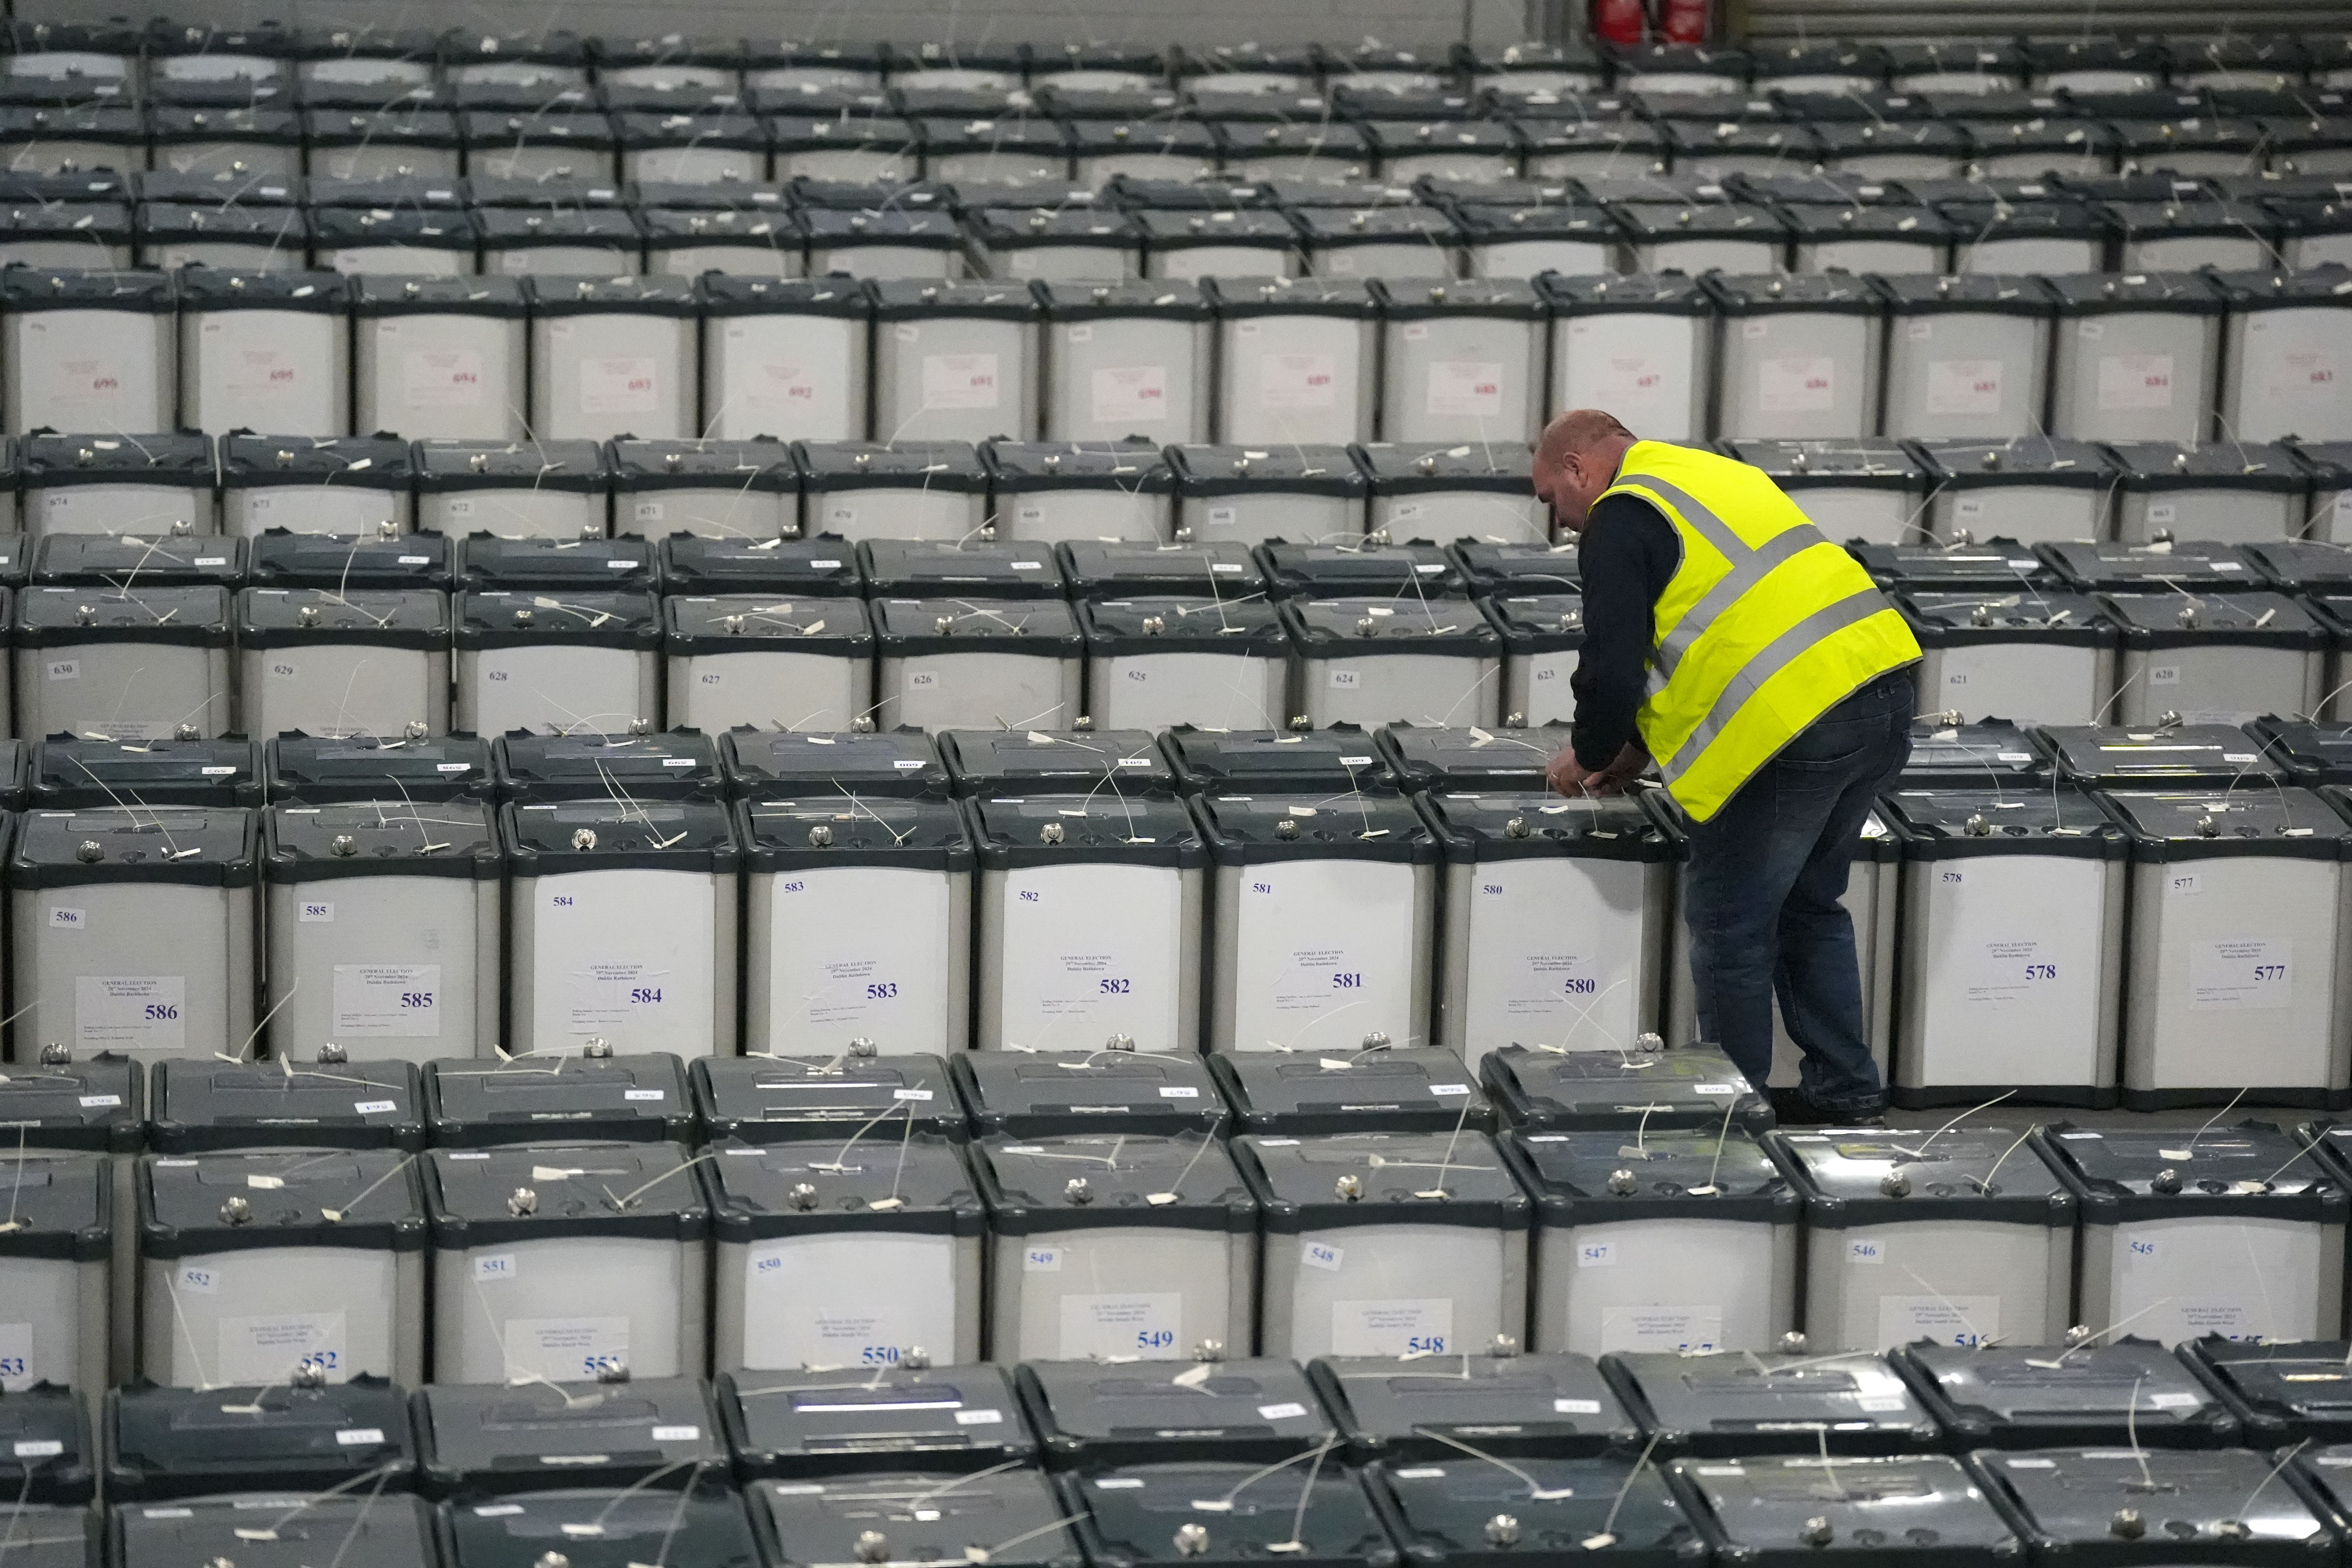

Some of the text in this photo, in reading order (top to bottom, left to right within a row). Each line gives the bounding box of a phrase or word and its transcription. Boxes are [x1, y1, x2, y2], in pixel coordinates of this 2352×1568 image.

[54, 664, 72, 673] 630
[275, 666, 293, 674] 629
[489, 672, 507, 681] 628
[914, 675, 932, 684] 626
[1129, 671, 1145, 680] 625
[1537, 670, 1554, 680] 623
[1950, 675, 1966, 684] 621
[2156, 670, 2173, 679] 620
[1943, 873, 1962, 882] 578
[785, 882, 804, 893] 583
[1253, 883, 1271, 893] 581
[2174, 878, 2193, 889] 577
[1483, 885, 1502, 895] 580
[554, 897, 573, 906] 584
[1020, 891, 1038, 901] 582
[306, 906, 326, 916] 585
[56, 912, 76, 922] 586
[2026, 965, 2055, 980] 578
[2255, 966, 2285, 980] 577
[1100, 979, 1129, 993] 582
[1333, 973, 1361, 988] 581
[1565, 979, 1595, 993] 580
[632, 989, 662, 1003] 584
[867, 983, 897, 999] 583
[401, 993, 432, 1007] 585
[145, 1005, 177, 1020] 586
[1586, 1248, 1606, 1258] 547
[1853, 1245, 1875, 1255] 546
[2132, 1242, 2152, 1253] 545
[1031, 1252, 1052, 1263] 549
[1313, 1248, 1334, 1260] 548
[483, 1260, 504, 1270] 551
[759, 1258, 780, 1269] 550
[187, 1272, 209, 1285] 552
[1138, 1331, 1173, 1348] 549
[1409, 1337, 1444, 1354] 548
[862, 1347, 898, 1364] 550
